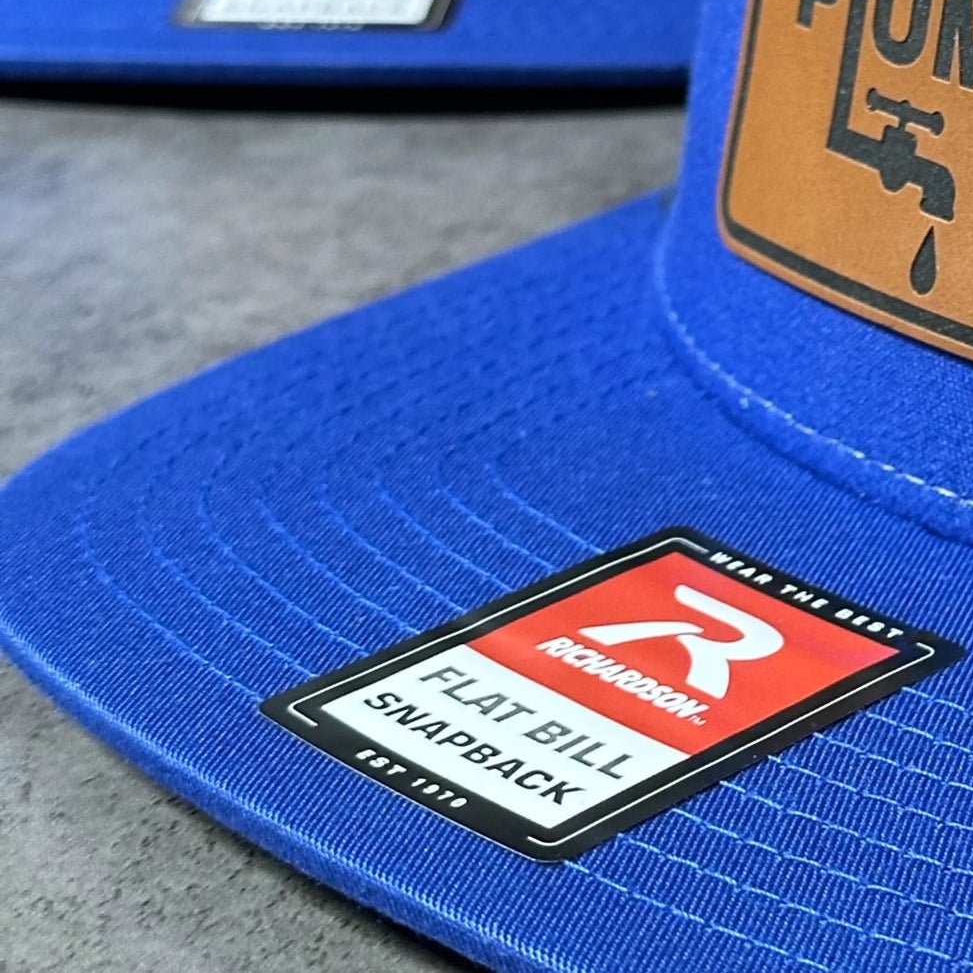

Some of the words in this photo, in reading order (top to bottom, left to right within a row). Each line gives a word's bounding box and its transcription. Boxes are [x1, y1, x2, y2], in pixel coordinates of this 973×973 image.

[709, 552, 773, 585] WEAR
[780, 584, 829, 609] THE
[834, 608, 904, 639] BEST
[363, 692, 588, 806] SNAPBACK
[418, 665, 538, 723] FLAT
[521, 719, 634, 780] BILL
[355, 748, 408, 775] EST
[410, 777, 468, 808] 1970
